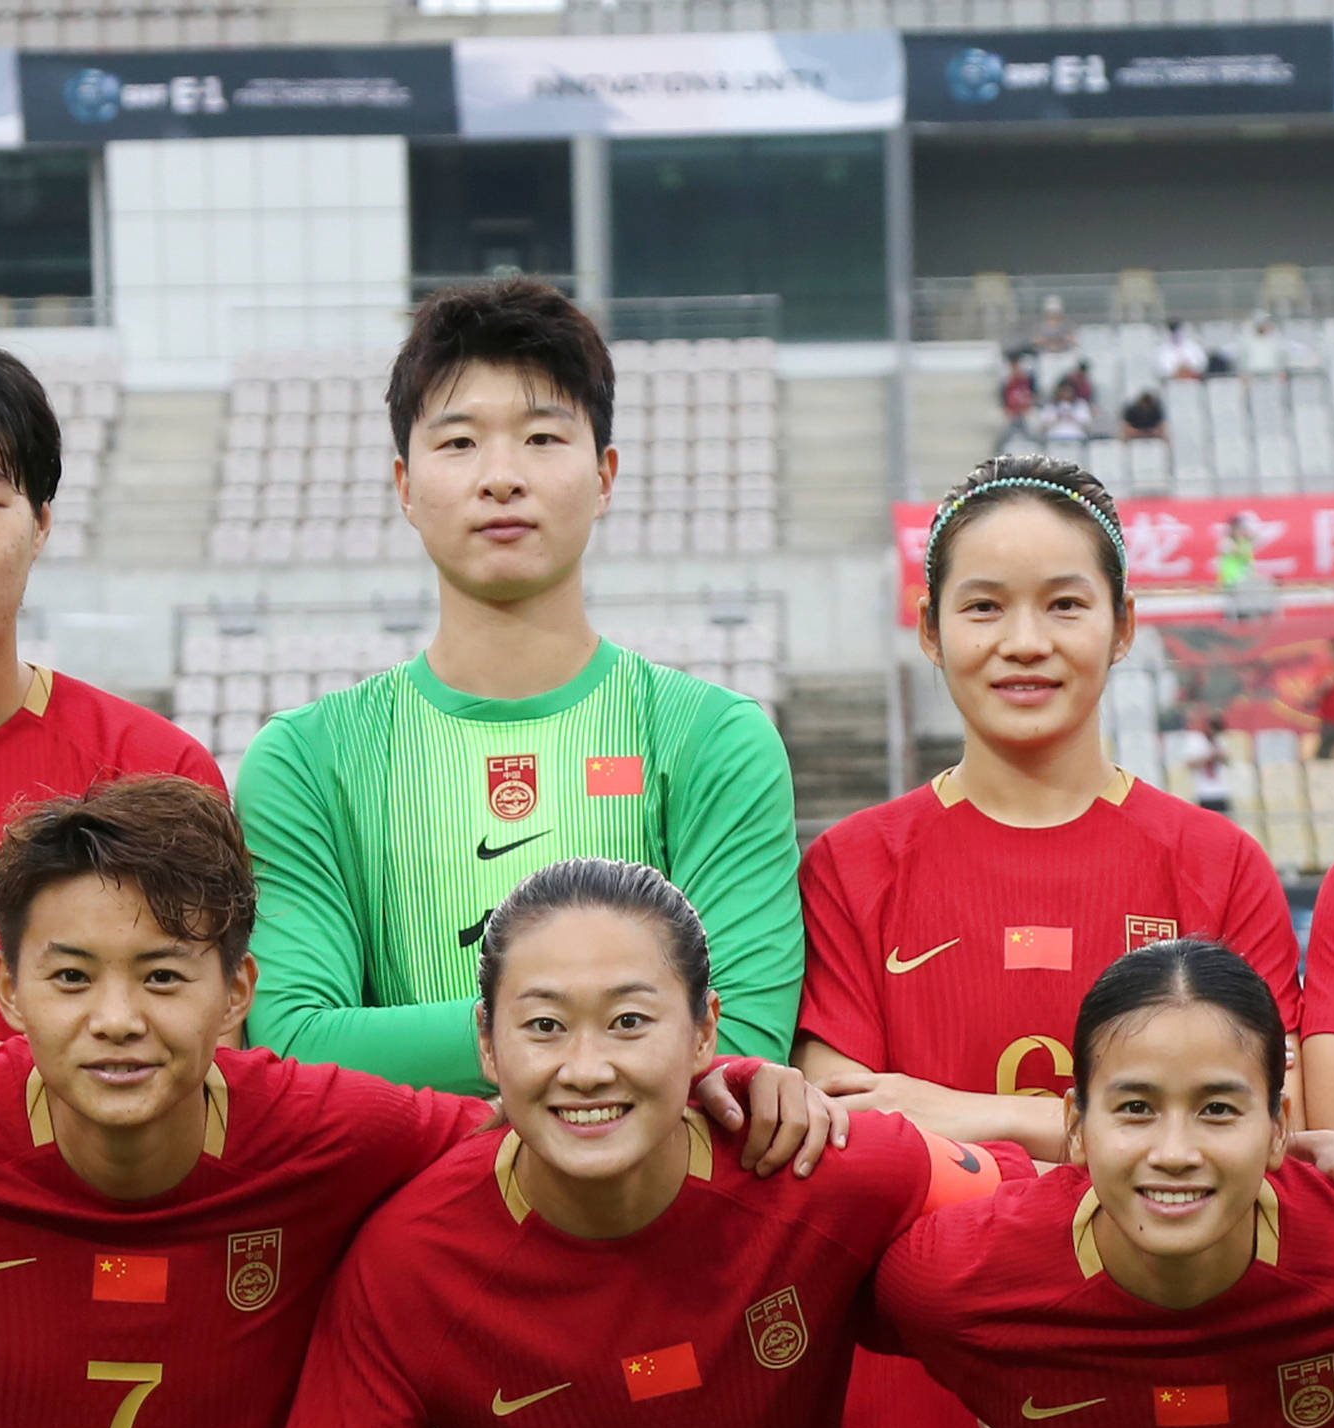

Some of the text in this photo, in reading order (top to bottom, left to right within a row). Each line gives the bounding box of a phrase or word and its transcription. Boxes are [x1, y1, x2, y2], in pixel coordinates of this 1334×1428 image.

[489, 757, 534, 773] CFA
[1130, 920, 1172, 938] CFA
[233, 1234, 277, 1254] CFA
[750, 1292, 793, 1323] CFA
[1284, 1358, 1331, 1380] CFA
